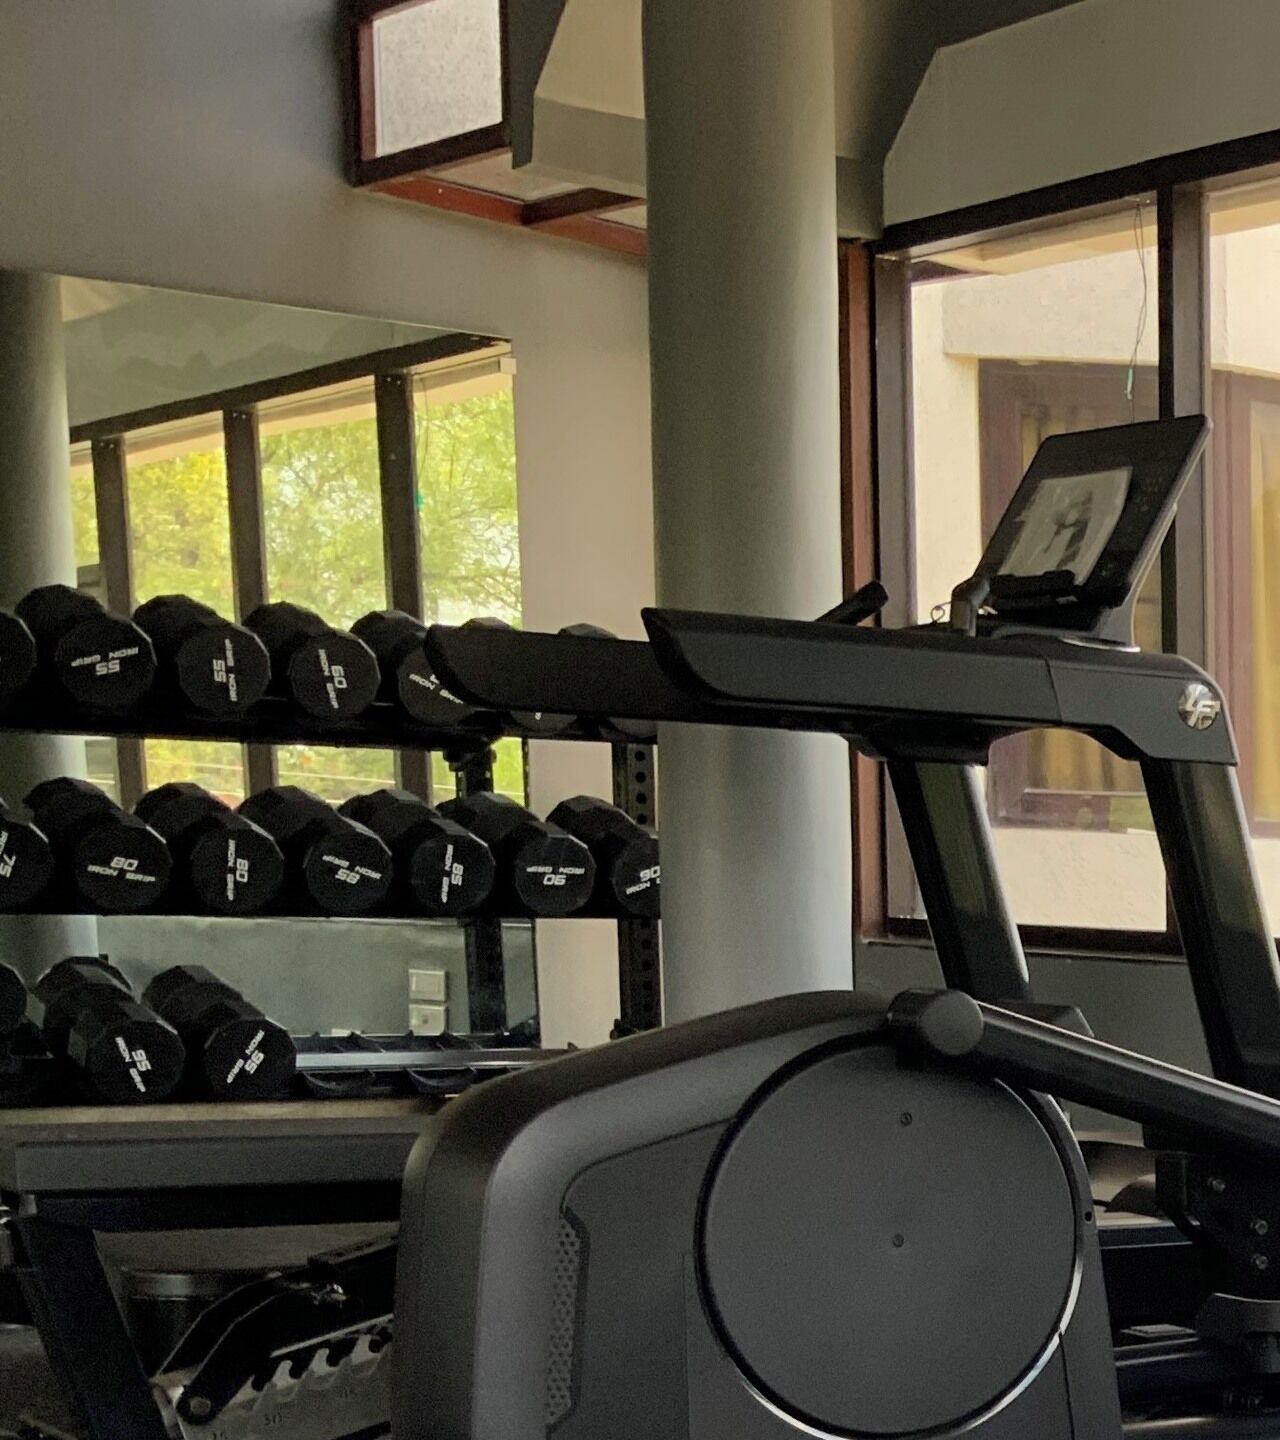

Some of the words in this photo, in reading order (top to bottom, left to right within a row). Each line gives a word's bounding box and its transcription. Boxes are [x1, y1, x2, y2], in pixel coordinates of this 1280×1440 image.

[109, 647, 138, 660] IRON
[318, 649, 330, 676] IRON
[96, 660, 120, 675] 55
[213, 659, 226, 682] 55
[331, 665, 347, 688] 60
[228, 673, 238, 701] IRON
[409, 673, 436, 690] IRON
[110, 856, 139, 870] 80
[228, 839, 236, 867] IRON
[444, 844, 454, 871] IRON
[0, 853, 16, 878] 75
[87, 864, 119, 876] IRON
[236, 858, 249, 883] 80
[335, 868, 361, 885] 85
[354, 865, 382, 880] IRON
[451, 863, 464, 886] 85
[559, 867, 585, 875] IRON
[639, 865, 661, 882] 90
[543, 874, 567, 886] 90
[626, 881, 650, 895] IRON
[115, 1036, 132, 1063] IRON
[245, 1029, 265, 1055] IRON
[131, 1049, 152, 1072] 95
[244, 1050, 265, 1074] 95
